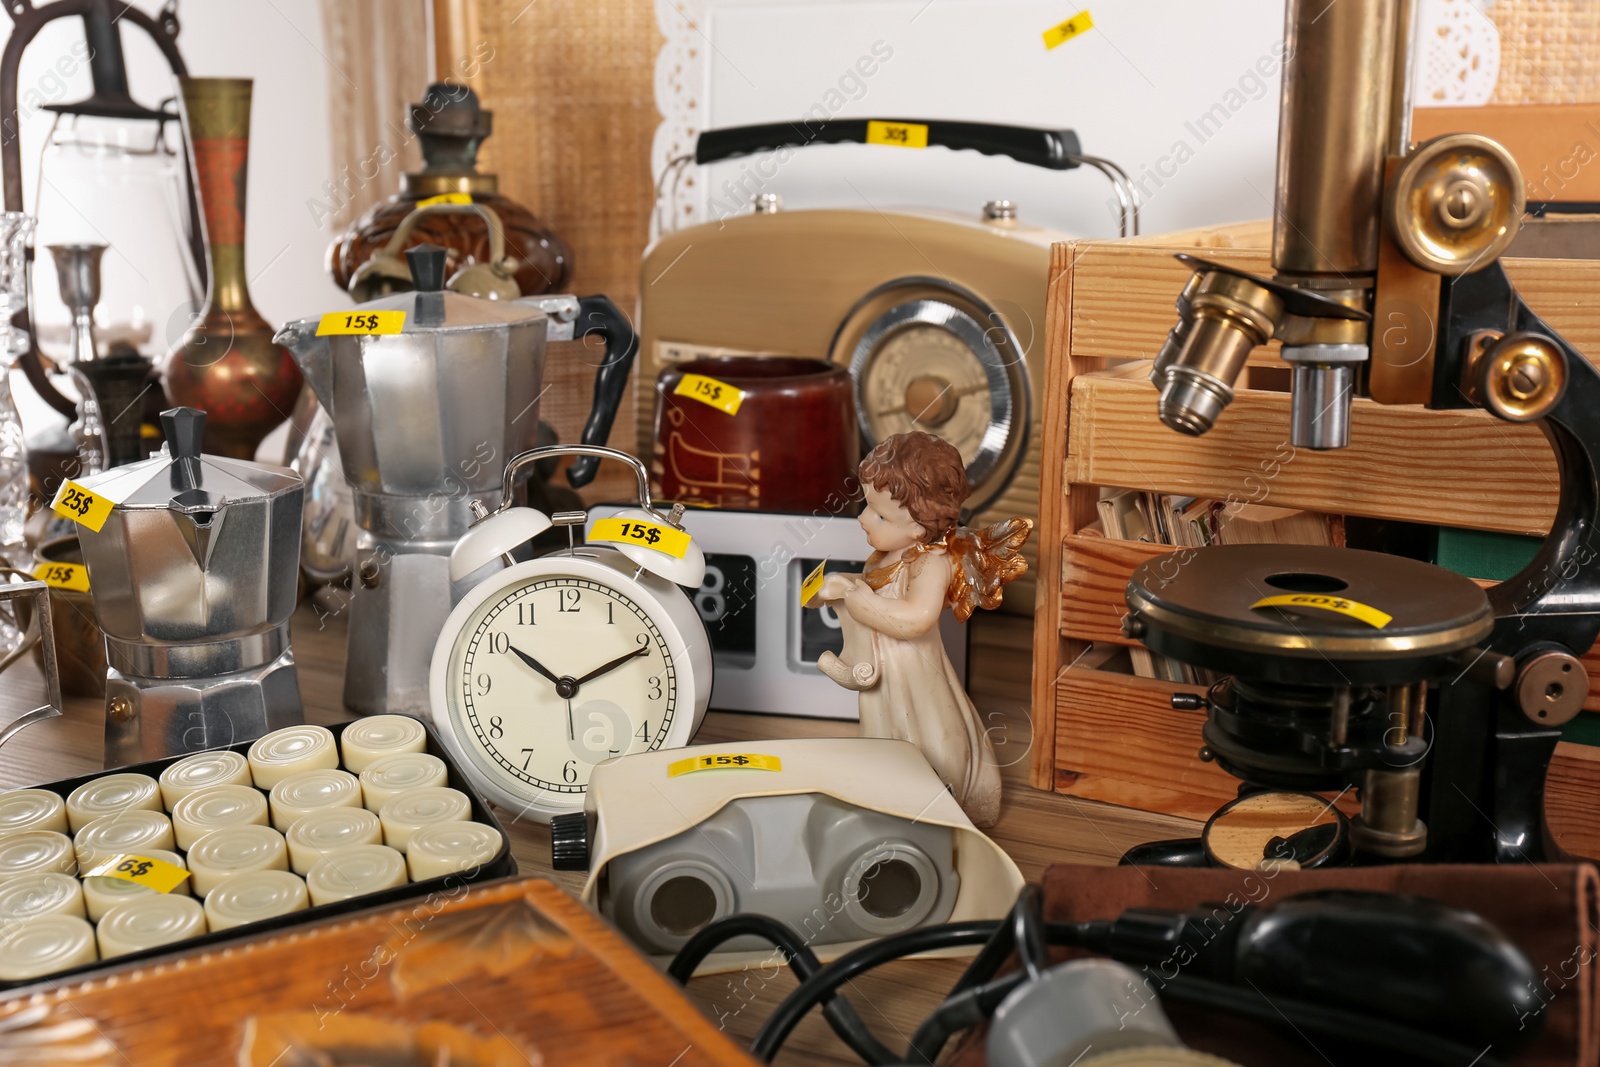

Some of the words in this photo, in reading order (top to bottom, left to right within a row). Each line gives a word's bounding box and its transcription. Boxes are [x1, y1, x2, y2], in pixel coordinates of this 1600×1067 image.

[345, 314, 379, 331] 15$
[695, 381, 722, 401] 15$
[62, 489, 93, 516] 25$
[620, 522, 662, 545] 15$
[46, 566, 73, 583] 15$
[557, 588, 581, 613] 12
[1291, 595, 1350, 609] 60$
[517, 602, 536, 626] 11
[605, 602, 615, 625] 1
[487, 631, 510, 655] 10
[636, 632, 651, 657] 2
[477, 672, 491, 697] 9
[648, 677, 662, 700] 3
[490, 715, 504, 740] 8
[634, 719, 651, 742] 4
[520, 749, 534, 771] 7
[562, 760, 577, 783] 6
[701, 755, 749, 767] 15$
[116, 859, 154, 877] 6$
